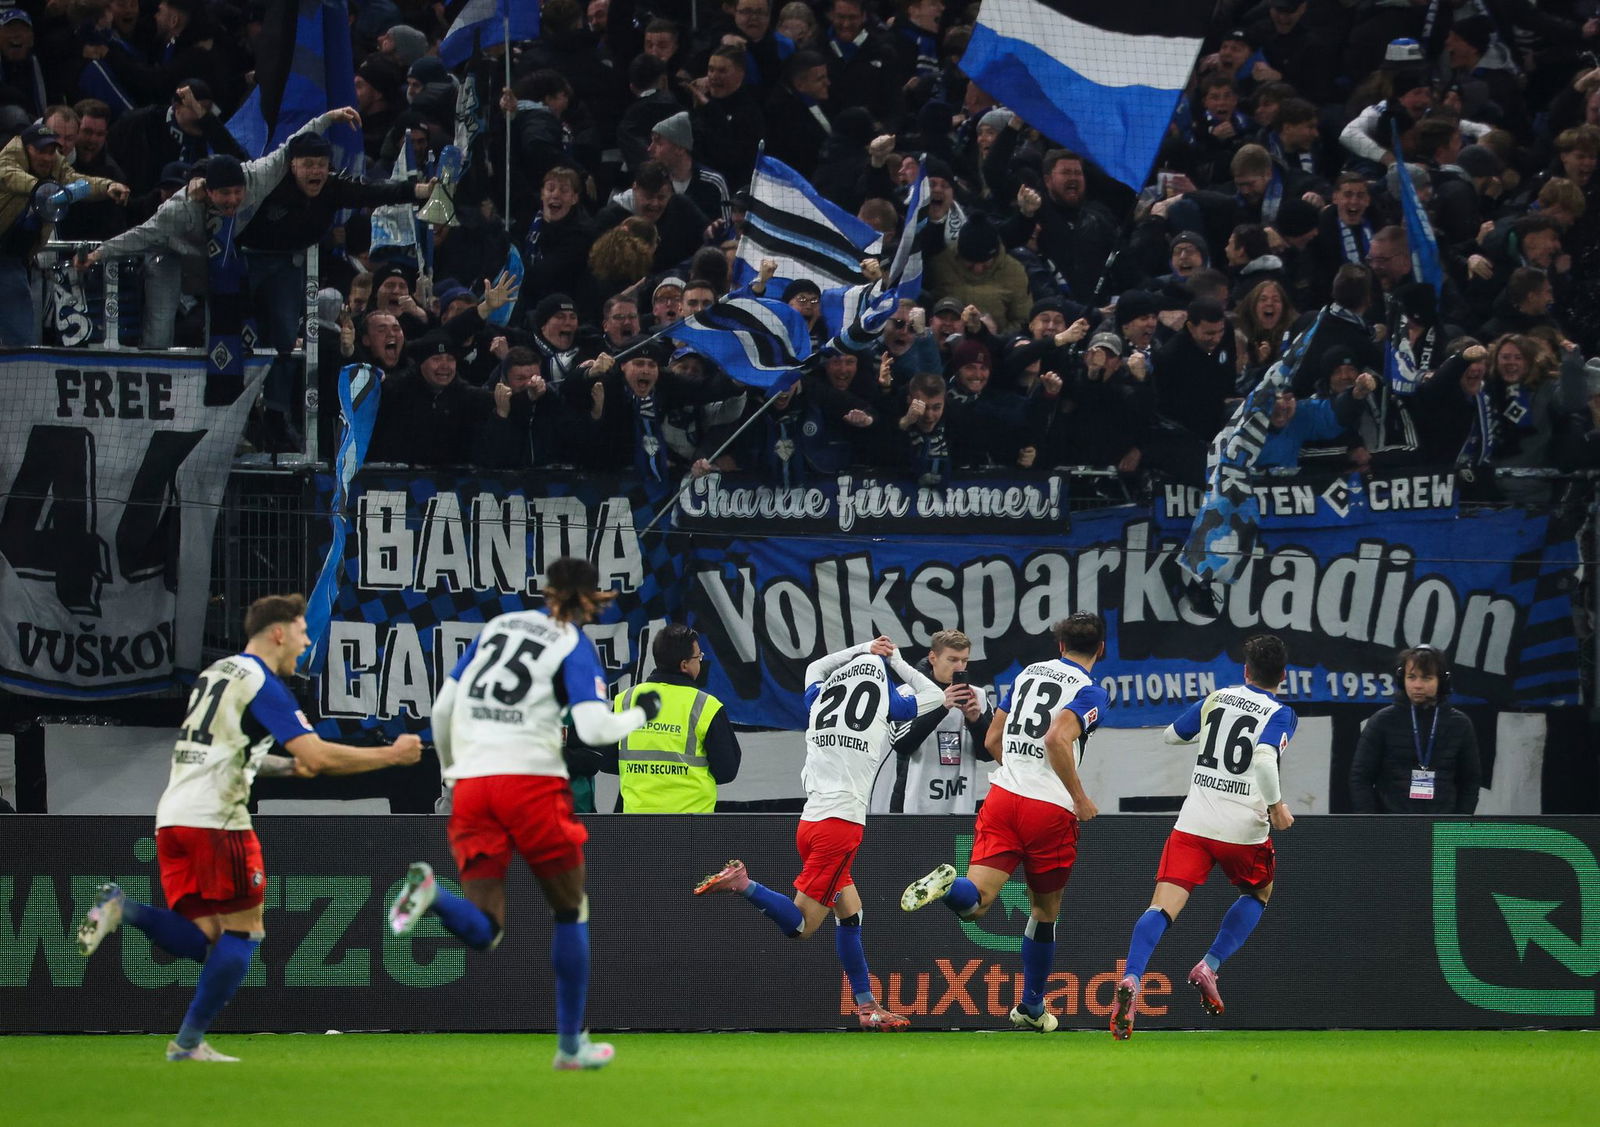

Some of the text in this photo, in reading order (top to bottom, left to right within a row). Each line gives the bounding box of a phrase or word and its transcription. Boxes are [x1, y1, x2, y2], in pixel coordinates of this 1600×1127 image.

[56, 369, 176, 421] FREE
[837, 474, 911, 532] für
[1165, 474, 1455, 518] HOTEN CREW
[358, 490, 644, 597] BANDA
[468, 633, 547, 706] 25
[1099, 671, 1216, 702] OTIONEN
[1326, 671, 1395, 697] 1953
[177, 676, 230, 746] 21
[815, 680, 881, 732] 20
[1007, 678, 1063, 739] 13
[837, 734, 869, 753] VIEIRA
[1006, 741, 1044, 759] AMOS
[1197, 706, 1260, 775] 16
[650, 764, 689, 776] SECURITY
[929, 775, 968, 800] SMF
